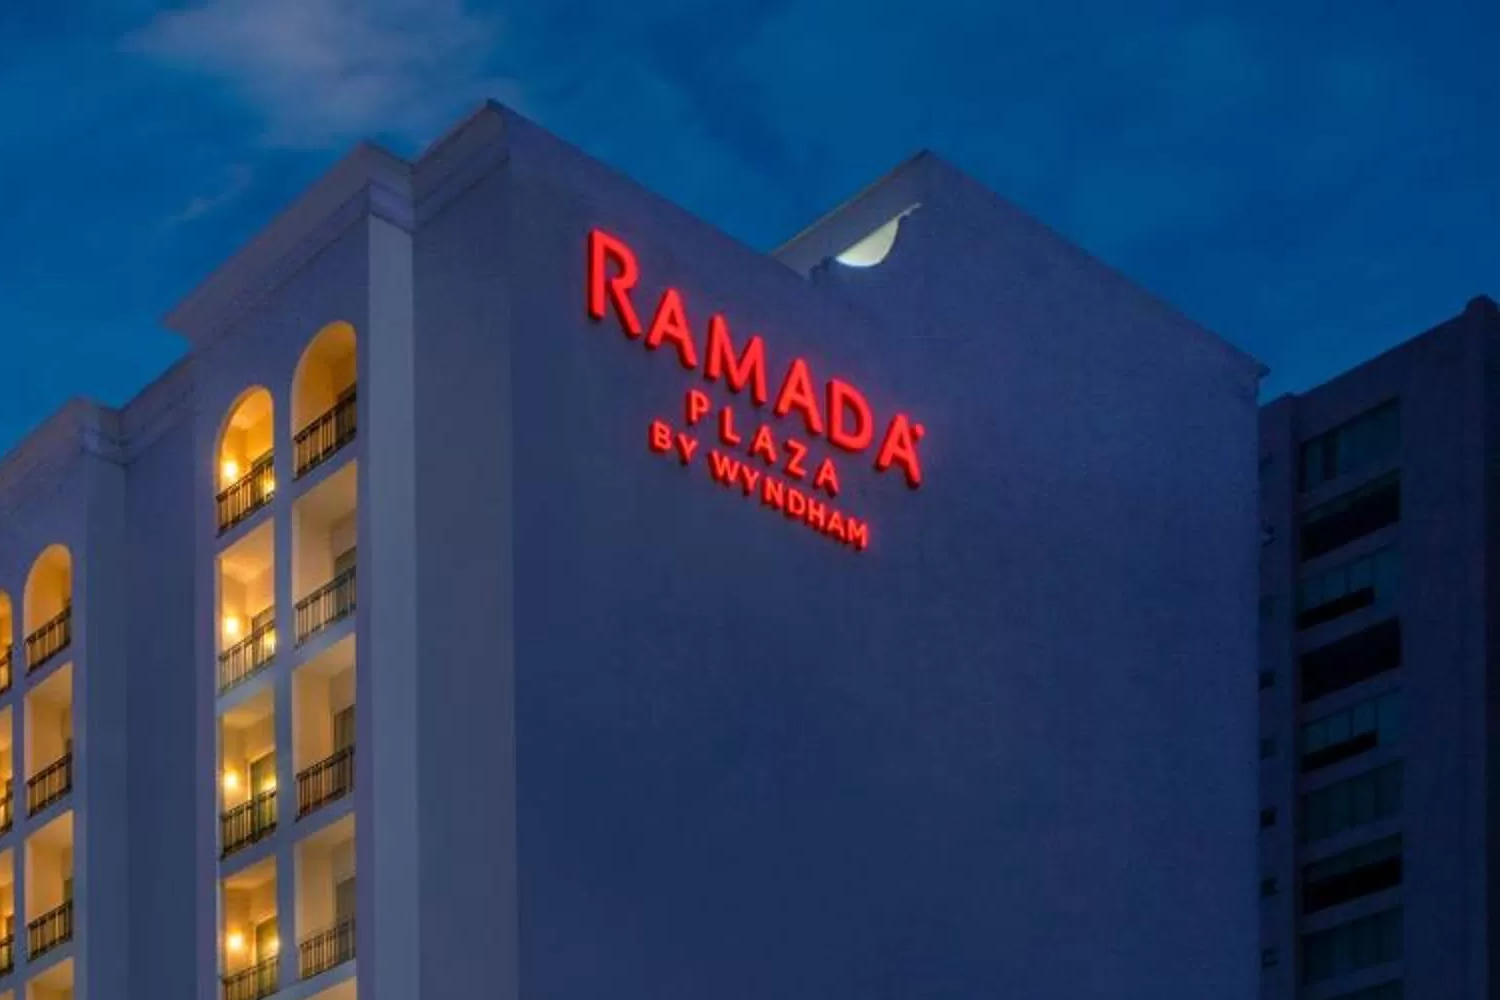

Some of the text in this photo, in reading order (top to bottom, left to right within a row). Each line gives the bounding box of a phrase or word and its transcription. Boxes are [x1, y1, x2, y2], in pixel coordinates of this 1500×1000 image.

[587, 229, 923, 488] RAMADA
[650, 421, 868, 550] BY WYNDHAM
[687, 390, 839, 495] PLAZA
